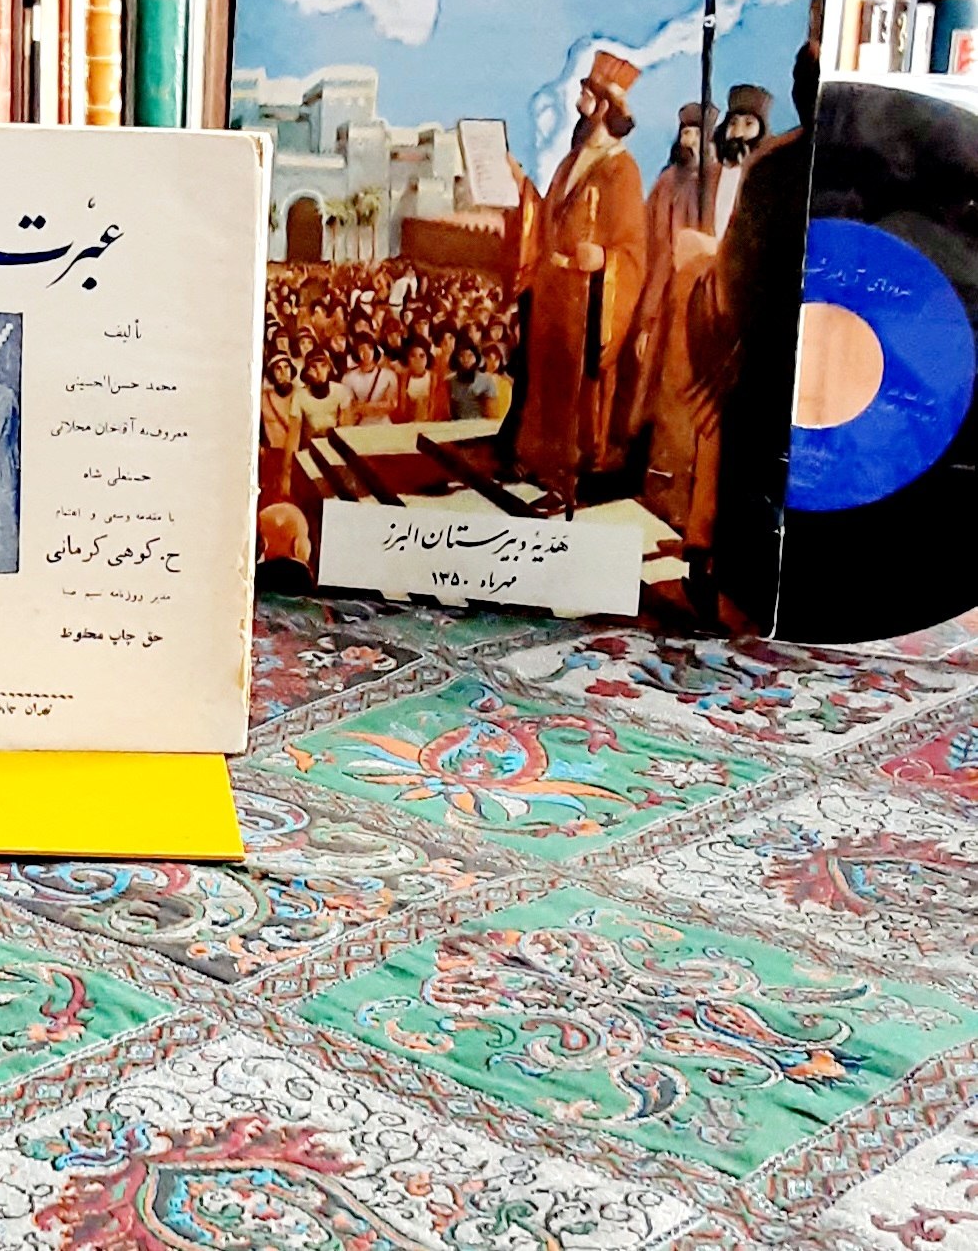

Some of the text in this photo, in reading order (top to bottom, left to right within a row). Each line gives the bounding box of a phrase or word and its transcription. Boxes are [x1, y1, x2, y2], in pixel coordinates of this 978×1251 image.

[145, 382, 177, 392] محمد
[82, 466, 103, 479] شاه
[382, 522, 419, 550] البرز
[421, 524, 527, 562] دبیرستان
[46, 533, 109, 563] کرمانی
[107, 536, 161, 567] کوهی
[431, 572, 470, 586] ۱۳۵۰
[108, 629, 136, 646] چاپ
[142, 631, 164, 648] حق
